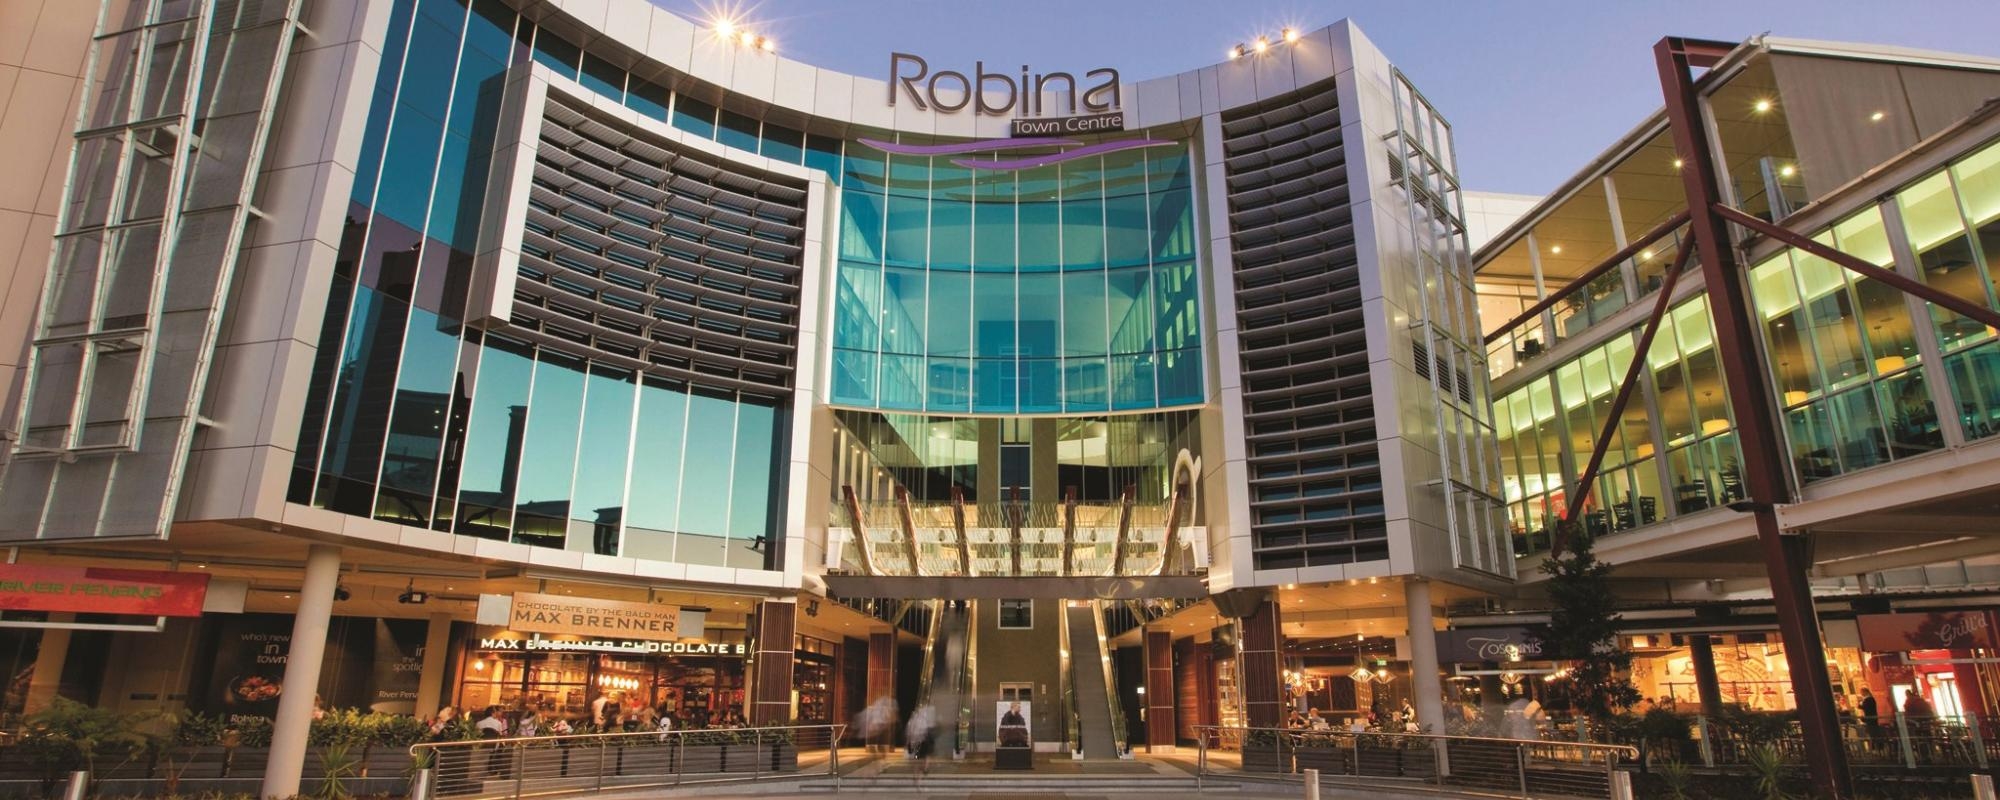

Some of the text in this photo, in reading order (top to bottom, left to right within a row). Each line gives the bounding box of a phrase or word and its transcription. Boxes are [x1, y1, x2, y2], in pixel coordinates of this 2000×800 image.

[888, 52, 1121, 116] Robina
[1013, 115, 1122, 134] Town Centre
[517, 601, 583, 613] CHOCOLATE
[602, 608, 624, 617] THE
[625, 610, 652, 618] BALD
[654, 612, 676, 620] MAN
[515, 609, 675, 633] MAX BRENNER
[264, 641, 280, 654] in
[481, 638, 519, 650] MAX
